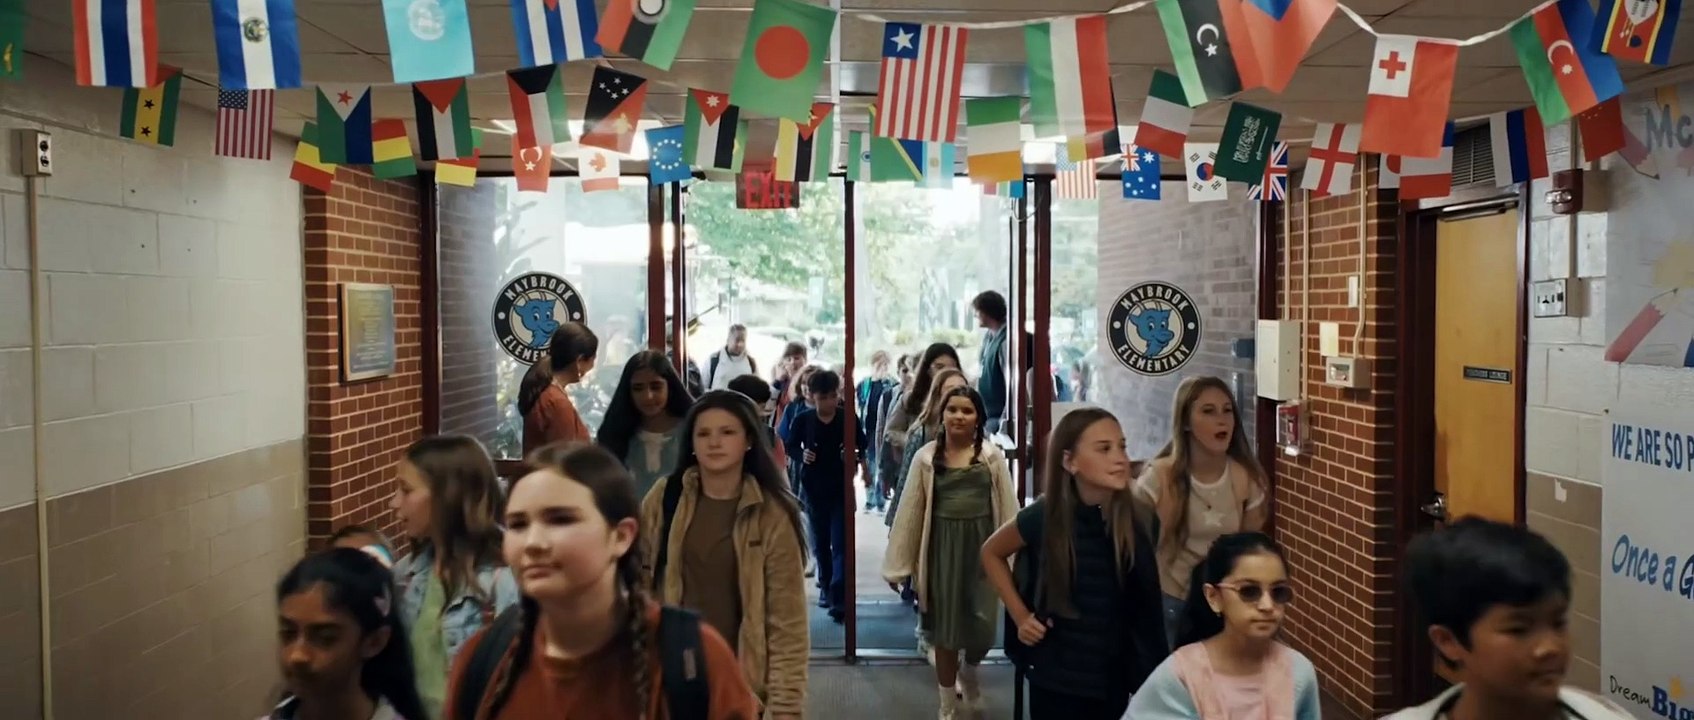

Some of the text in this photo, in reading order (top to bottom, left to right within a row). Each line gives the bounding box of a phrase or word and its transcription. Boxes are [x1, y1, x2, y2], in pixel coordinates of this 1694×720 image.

[504, 276, 574, 301] MAYBROOK
[1120, 286, 1189, 310] MAYBROOK
[503, 335, 551, 361] ELEMEN
[1117, 344, 1190, 371] ELEMENTARY
[1612, 423, 1632, 460] WE
[1635, 428, 1661, 466] ARE
[1665, 432, 1682, 470] SO
[1612, 534, 1659, 585] Once
[1663, 555, 1676, 592] a
[1609, 675, 1651, 709] Dream
